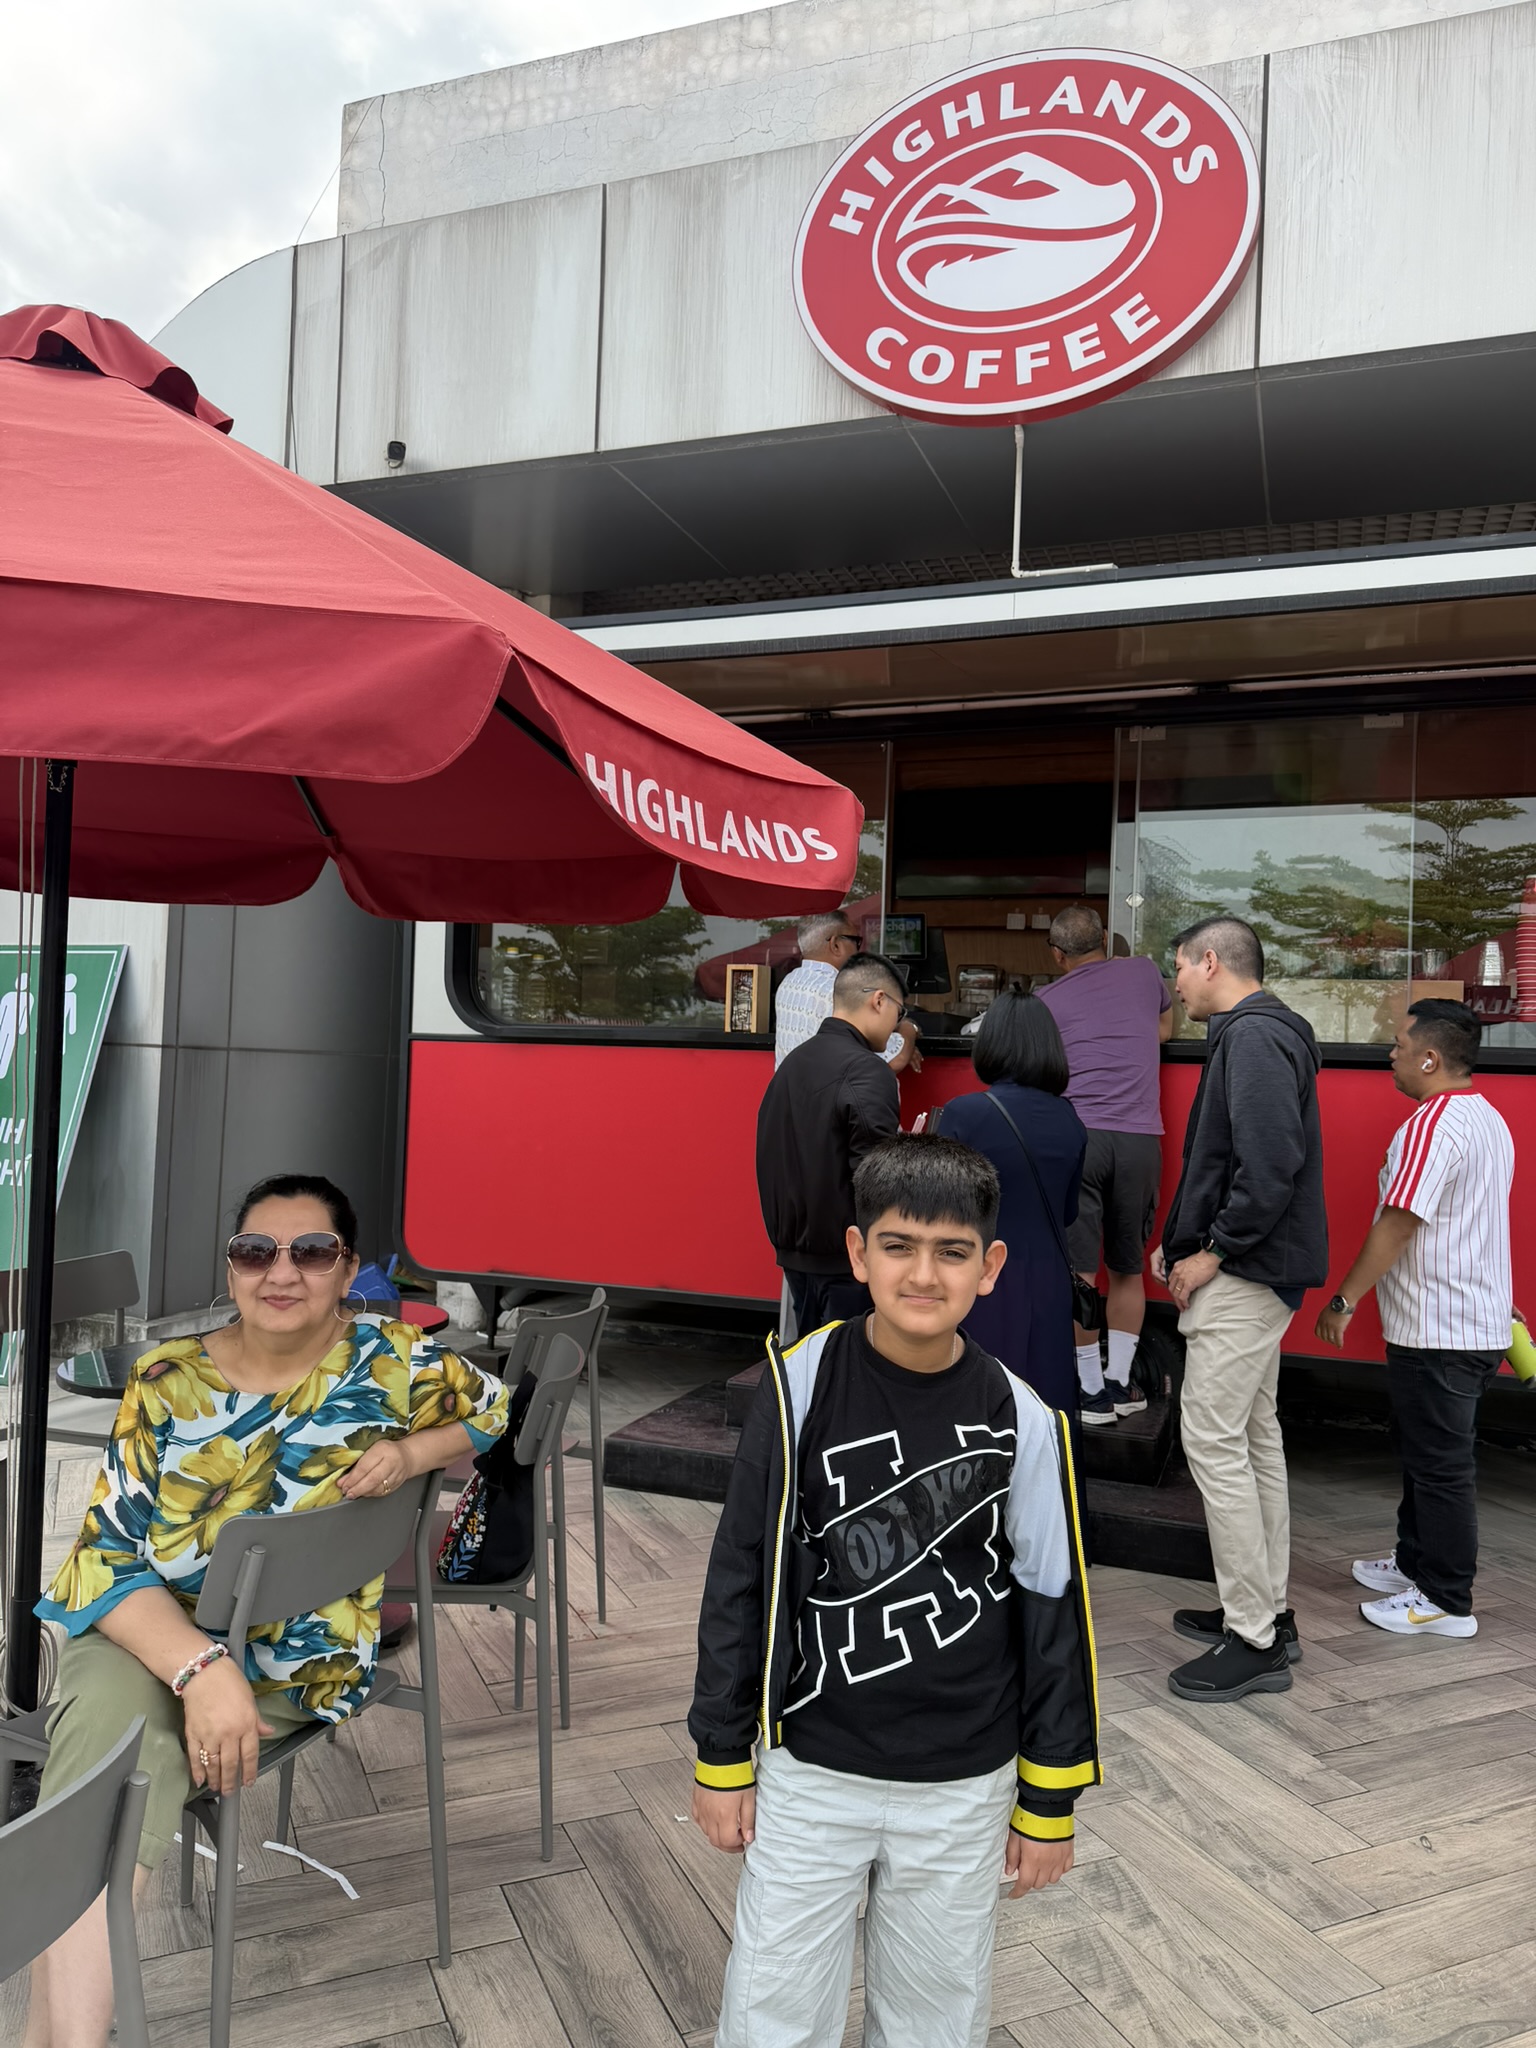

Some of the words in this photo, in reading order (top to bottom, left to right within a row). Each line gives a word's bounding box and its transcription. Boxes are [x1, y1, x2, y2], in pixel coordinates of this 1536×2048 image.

[829, 75, 1219, 236] HIGHLANDS
[866, 293, 1161, 389] COFFEE
[585, 752, 838, 863] HIGHLANDS
